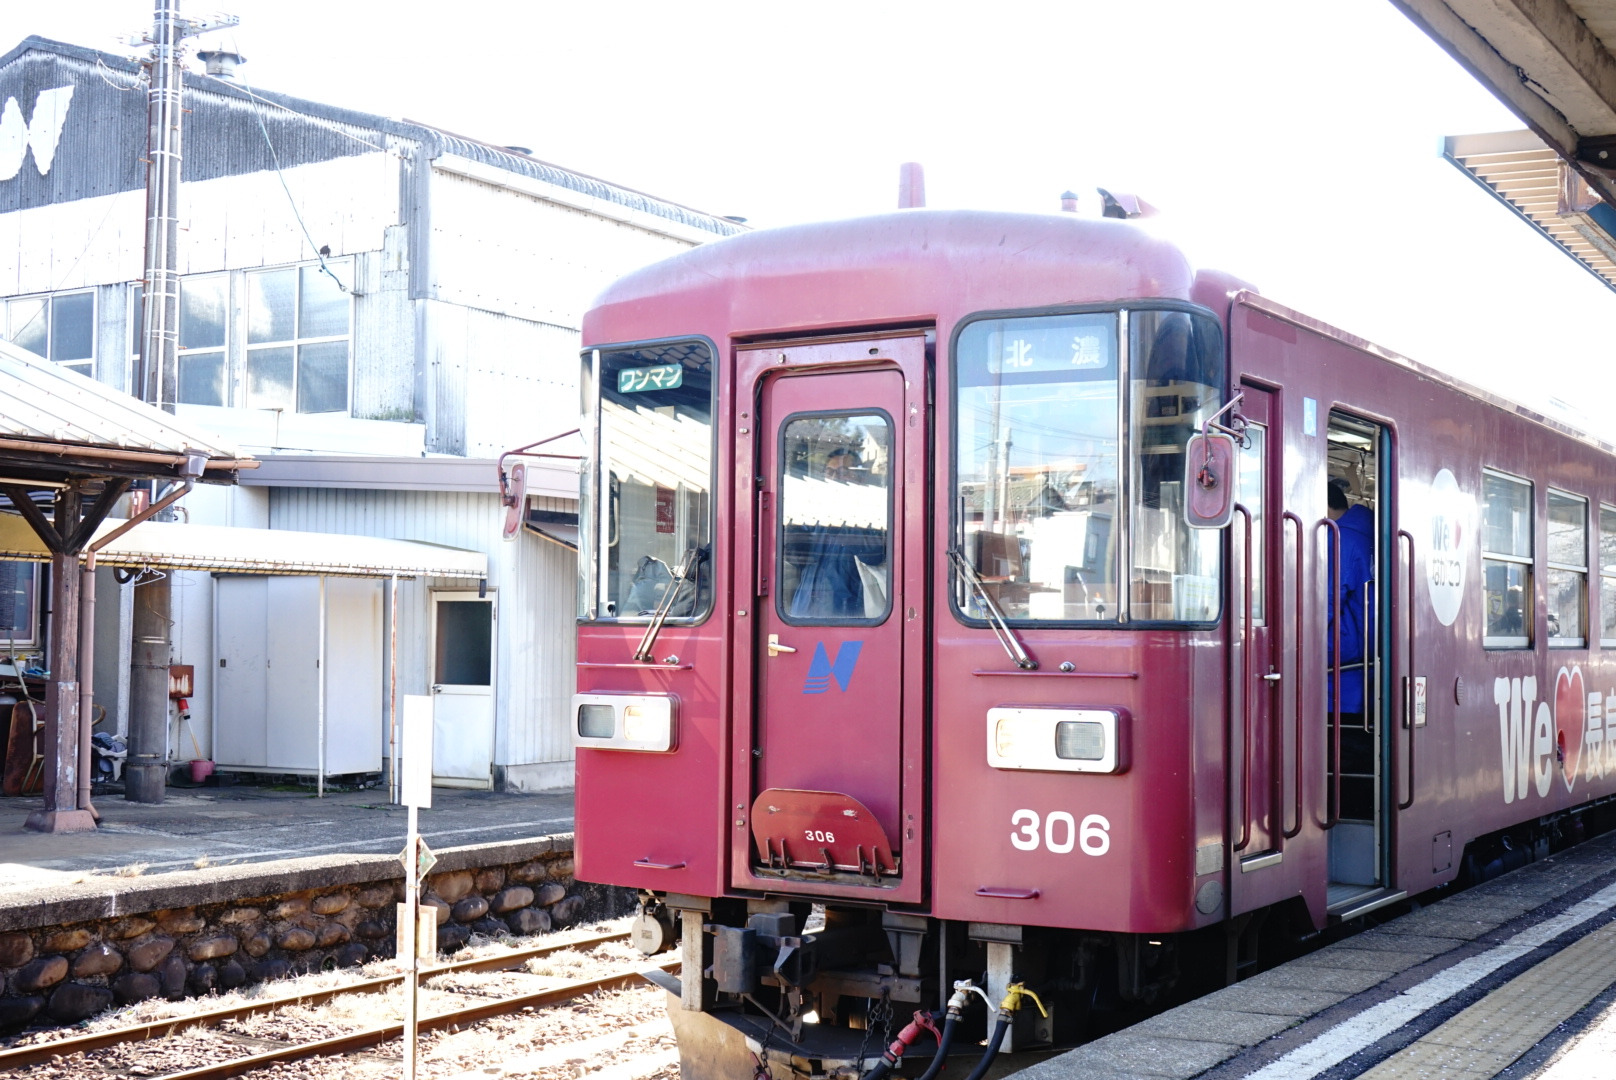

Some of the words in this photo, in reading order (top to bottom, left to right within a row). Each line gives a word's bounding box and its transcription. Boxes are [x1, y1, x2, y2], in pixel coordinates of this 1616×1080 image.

[1005, 335, 1100, 368] 北濃
[620, 367, 681, 392] ワンマン
[1494, 675, 1553, 804] We
[804, 830, 836, 843] 306
[1010, 808, 1111, 857] 306
